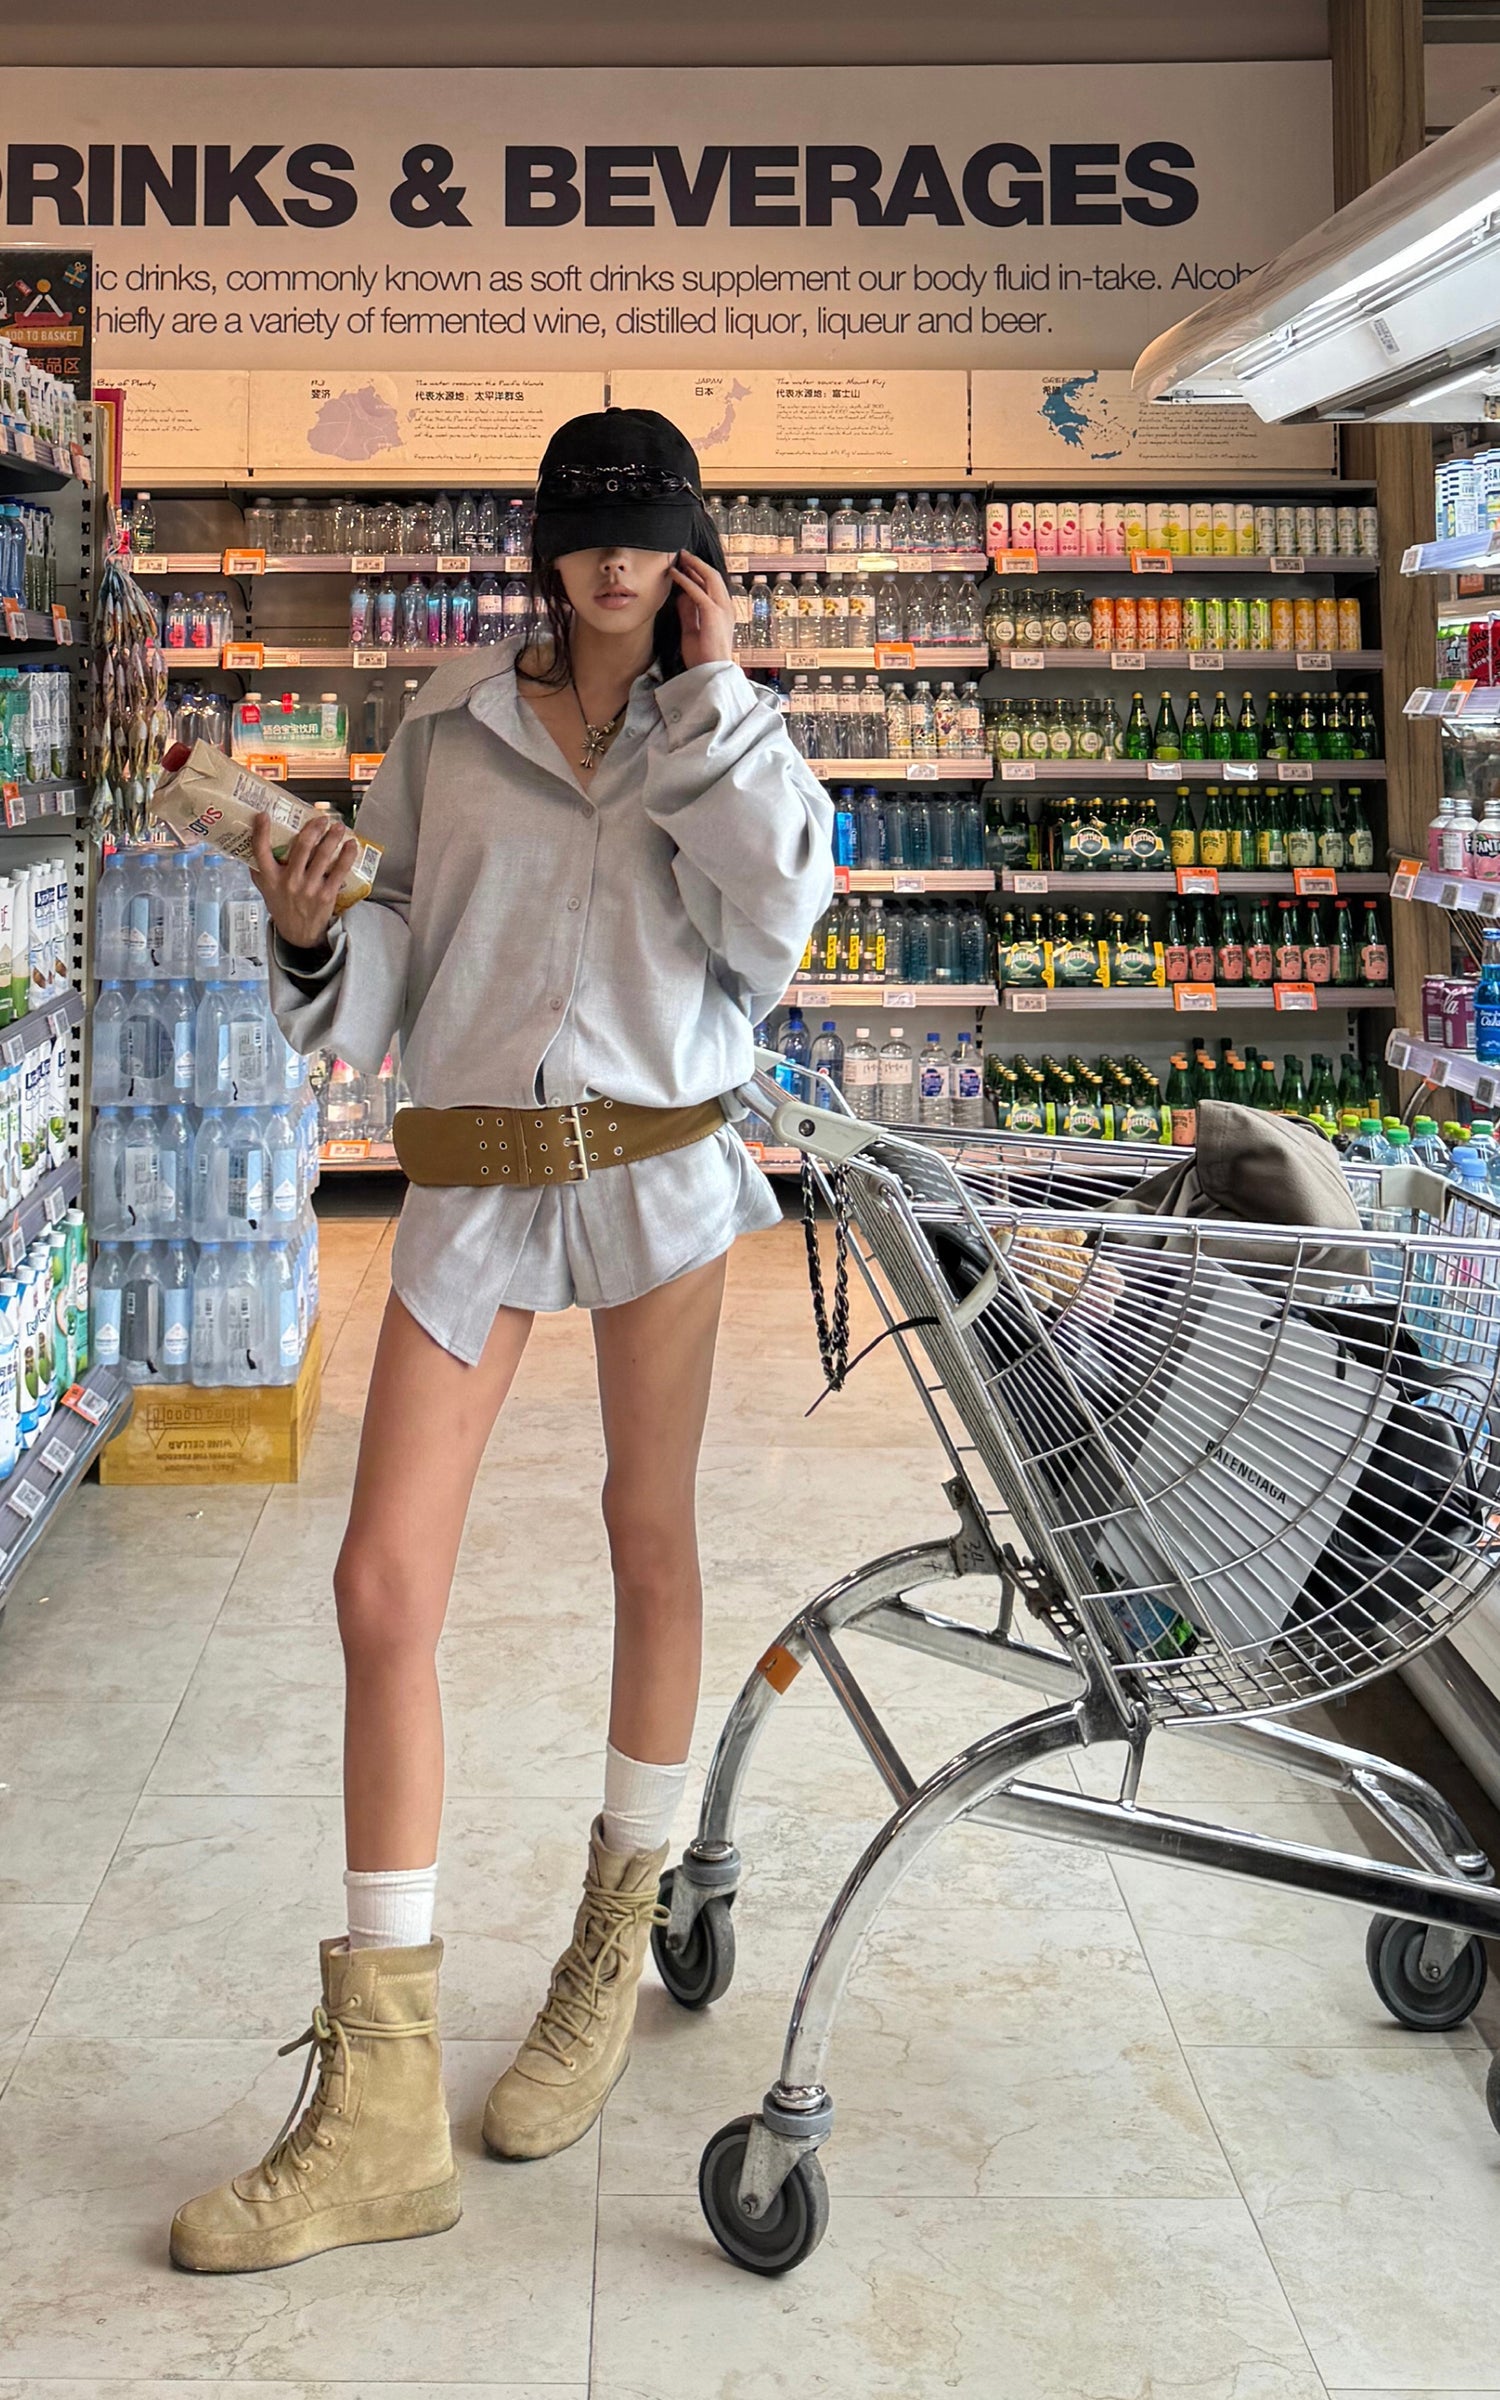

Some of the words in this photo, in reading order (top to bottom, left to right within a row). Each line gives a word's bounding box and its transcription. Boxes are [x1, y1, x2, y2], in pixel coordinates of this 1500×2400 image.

[0, 144, 358, 229] RINKS
[390, 144, 474, 229] &
[505, 142, 1199, 228] BEVERAGES
[95, 264, 118, 292] ic
[126, 264, 217, 296] drinks,
[227, 265, 378, 298] commonly
[386, 264, 481, 292] known
[490, 271, 522, 292] as
[531, 264, 583, 292] soft
[590, 264, 675, 292] drinks
[683, 264, 851, 298] supplement
[859, 271, 907, 292] our
[914, 264, 986, 298] body
[994, 264, 1050, 292] fluid
[1058, 264, 1163, 292] in-take.
[95, 306, 165, 340] hiefly
[172, 313, 218, 334] are
[225, 313, 242, 334] a
[249, 306, 341, 340] variety
[347, 306, 376, 334] of
[380, 306, 526, 335] fermented
[533, 307, 605, 339] wine,
[615, 306, 715, 334] distilled
[726, 306, 808, 341] liquor,
[817, 306, 911, 341] liqueur
[917, 306, 973, 334] and
[982, 306, 1052, 334] beer.
[27, 330, 38, 341] TO
[41, 330, 78, 342] BASKET
[117, 379, 129, 387] of
[845, 377, 870, 386] Mount
[695, 387, 714, 397] 日本
[1474, 838, 1500, 853] FANT
[1204, 1440, 1287, 1504] BALENCIAGA
